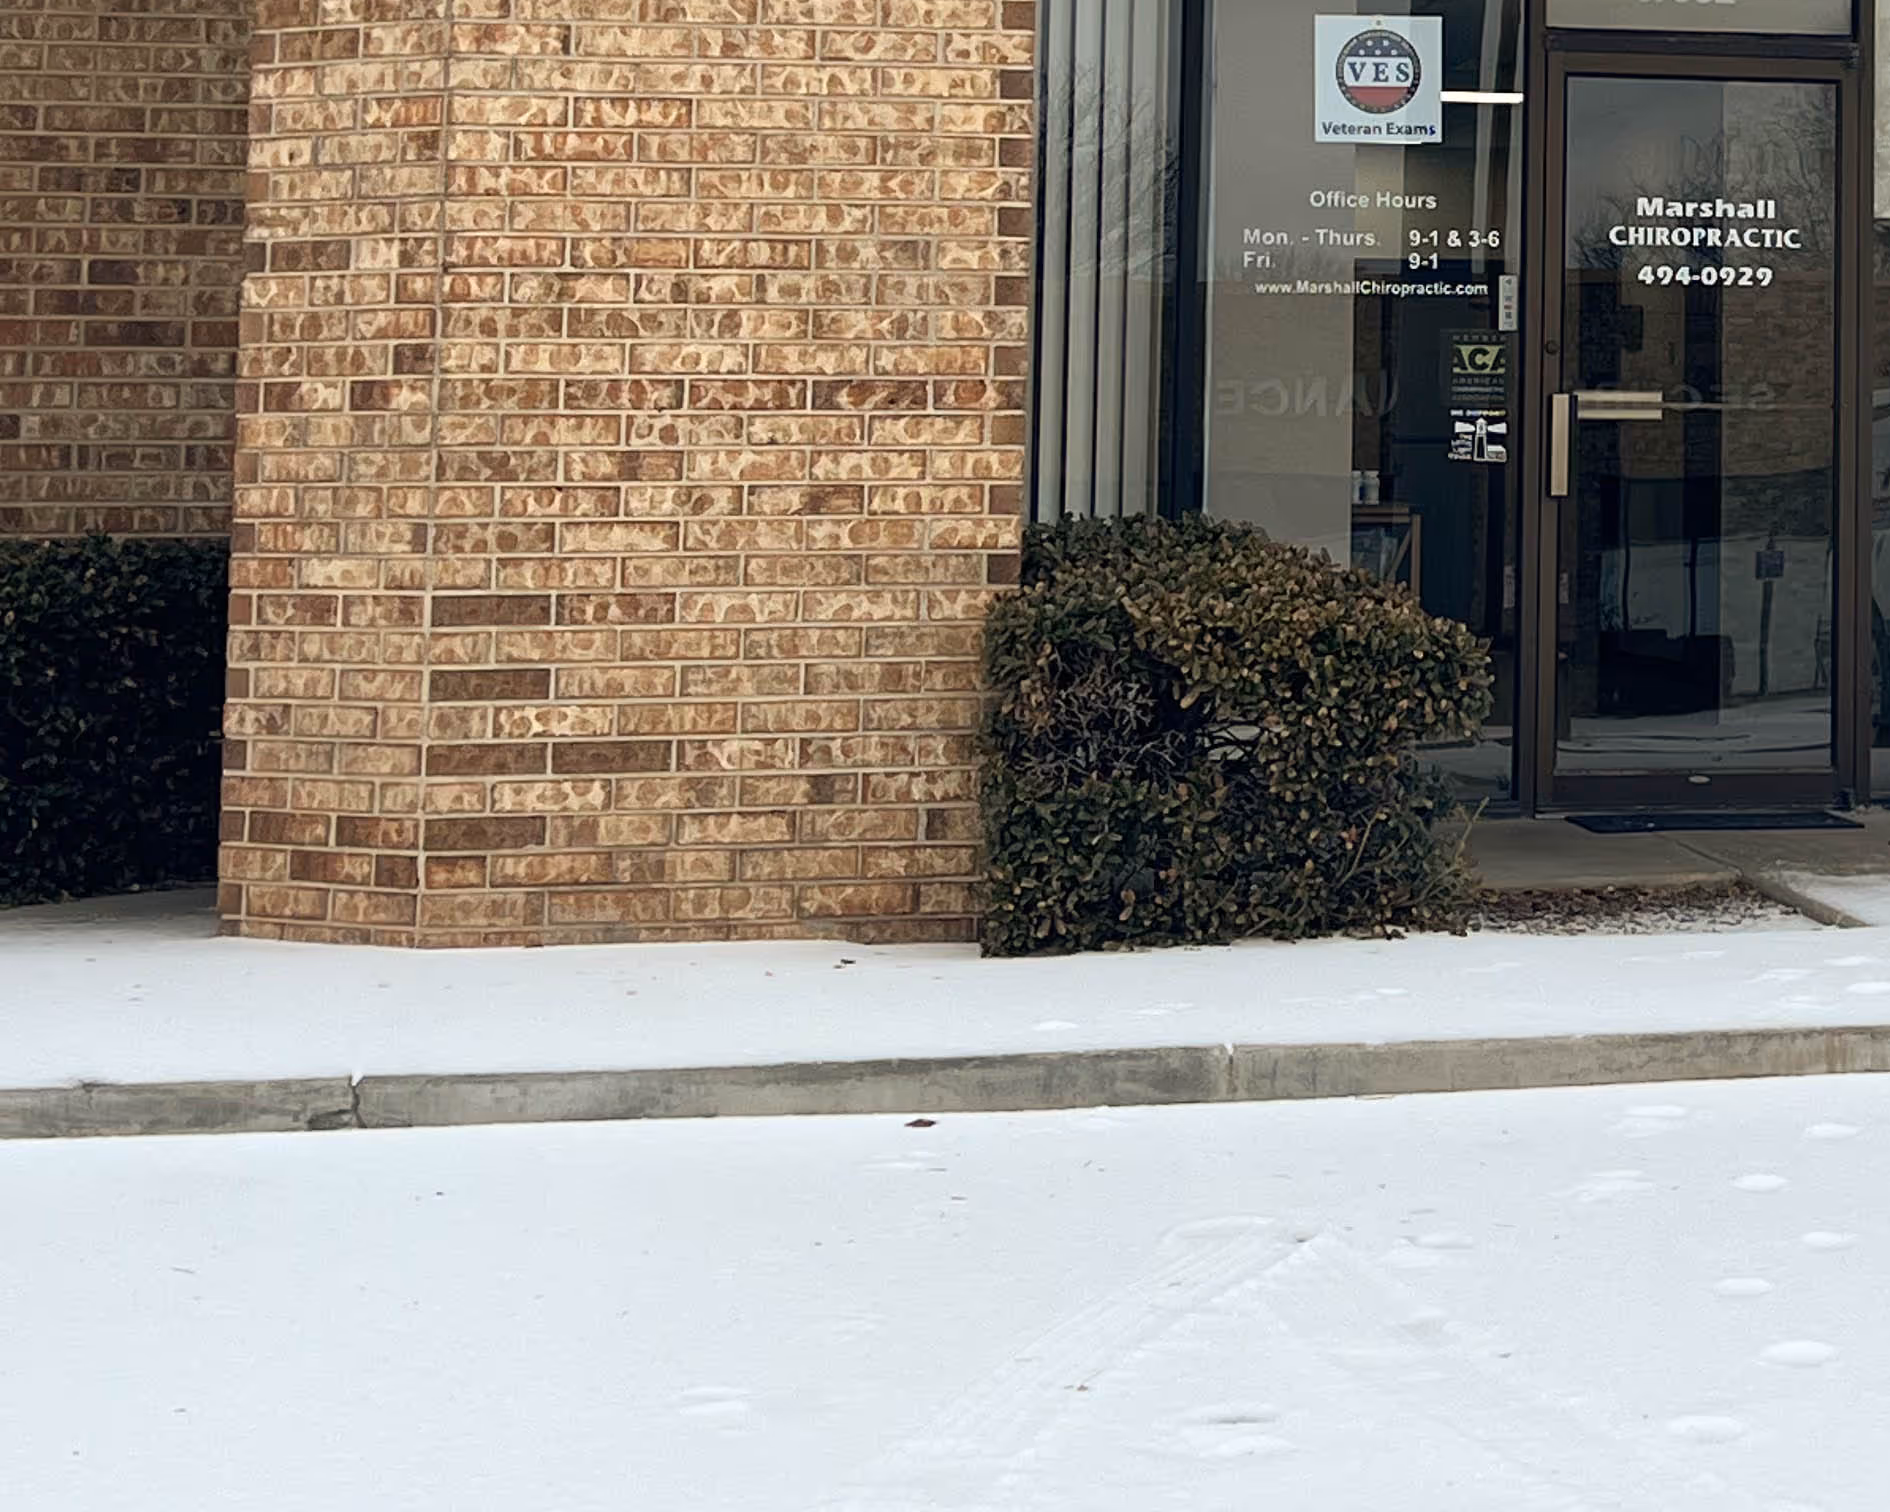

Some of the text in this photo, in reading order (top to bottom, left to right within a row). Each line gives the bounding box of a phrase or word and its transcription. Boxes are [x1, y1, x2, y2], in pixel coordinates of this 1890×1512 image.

[1348, 60, 1411, 84] VES
[1322, 122, 1436, 137] Veteran Exams
[1310, 191, 1437, 209] Office Hours
[1636, 197, 1775, 219] Marshall
[1243, 229, 1294, 245] Mon.
[1315, 229, 1381, 247] Thurs.
[1408, 230, 1439, 247] 9-1
[1447, 231, 1462, 247] &
[1468, 230, 1499, 247] 3-6
[1609, 225, 1802, 249] CHIROPRACTIC
[1243, 251, 1438, 269] Fri. 9-1
[1637, 264, 1773, 287] 494-0929
[1255, 280, 1488, 298] www.MarshallChiropractic.com
[1452, 346, 1506, 371] ACA
